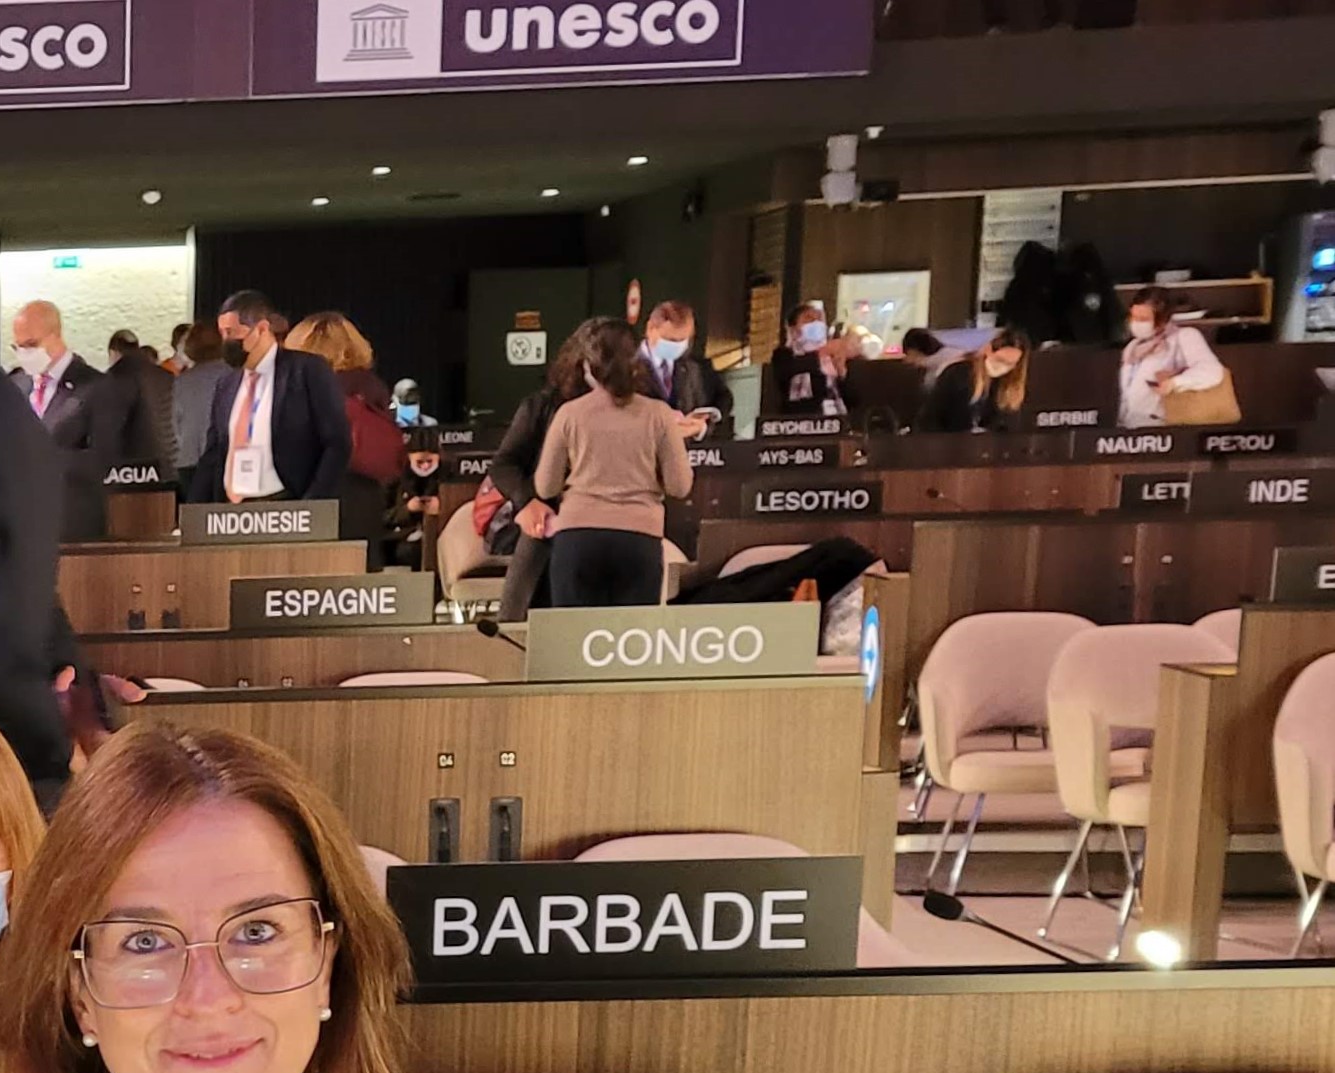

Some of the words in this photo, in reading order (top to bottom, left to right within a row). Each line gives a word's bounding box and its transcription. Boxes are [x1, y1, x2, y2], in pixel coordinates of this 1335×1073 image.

[465, 0, 719, 53] unesco
[762, 420, 840, 436] SEYCHELLES
[1036, 410, 1098, 427] SERBIE
[1097, 435, 1172, 454] NAURU
[1206, 435, 1275, 452] PEROU
[688, 449, 725, 467] EPAL
[103, 466, 159, 484] AGUA
[755, 489, 870, 513] LESOTHO
[1249, 479, 1310, 503] INDE
[206, 510, 311, 536] INDONESIE
[265, 586, 397, 617] ESPAGNE
[581, 625, 765, 669] CONGO
[432, 889, 809, 958] BARBADE
